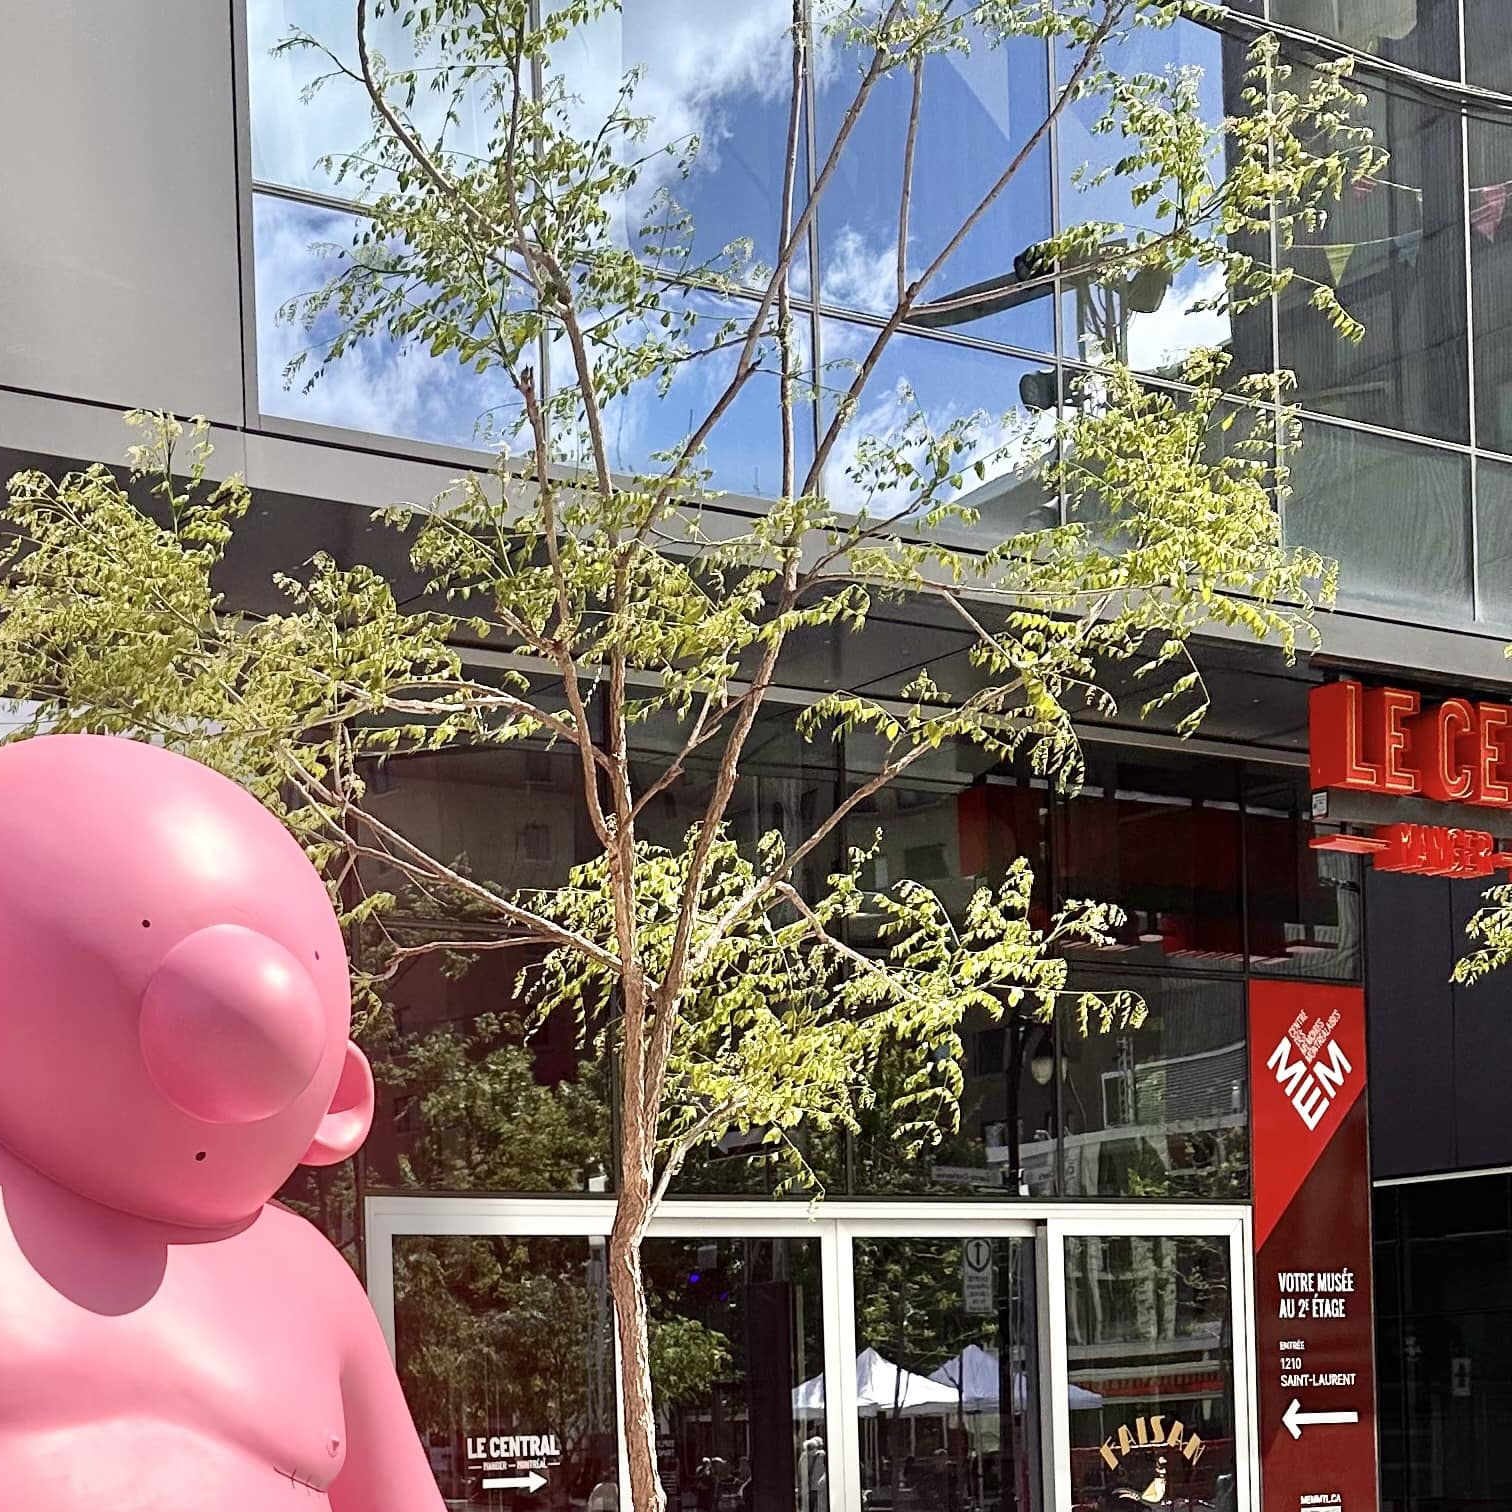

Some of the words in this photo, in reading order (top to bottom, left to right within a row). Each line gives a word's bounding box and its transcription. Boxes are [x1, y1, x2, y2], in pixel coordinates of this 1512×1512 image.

[1344, 681, 1420, 793] LE
[1439, 698, 1511, 806] CE
[1266, 1036, 1353, 1131] MEM
[1278, 1272, 1315, 1293] VOTRE
[1317, 1267, 1355, 1292] MUSÉE
[1279, 1298, 1296, 1319] AU
[1312, 1293, 1346, 1318] ÉTAGE
[1279, 1340, 1305, 1350] ENTRÉE
[1280, 1357, 1302, 1370] 1210
[1280, 1373, 1357, 1387] SAINT-LAURENT
[467, 1437, 487, 1459] LE
[489, 1434, 561, 1458] CENTRAL
[1099, 1415, 1206, 1471] FAISAN
